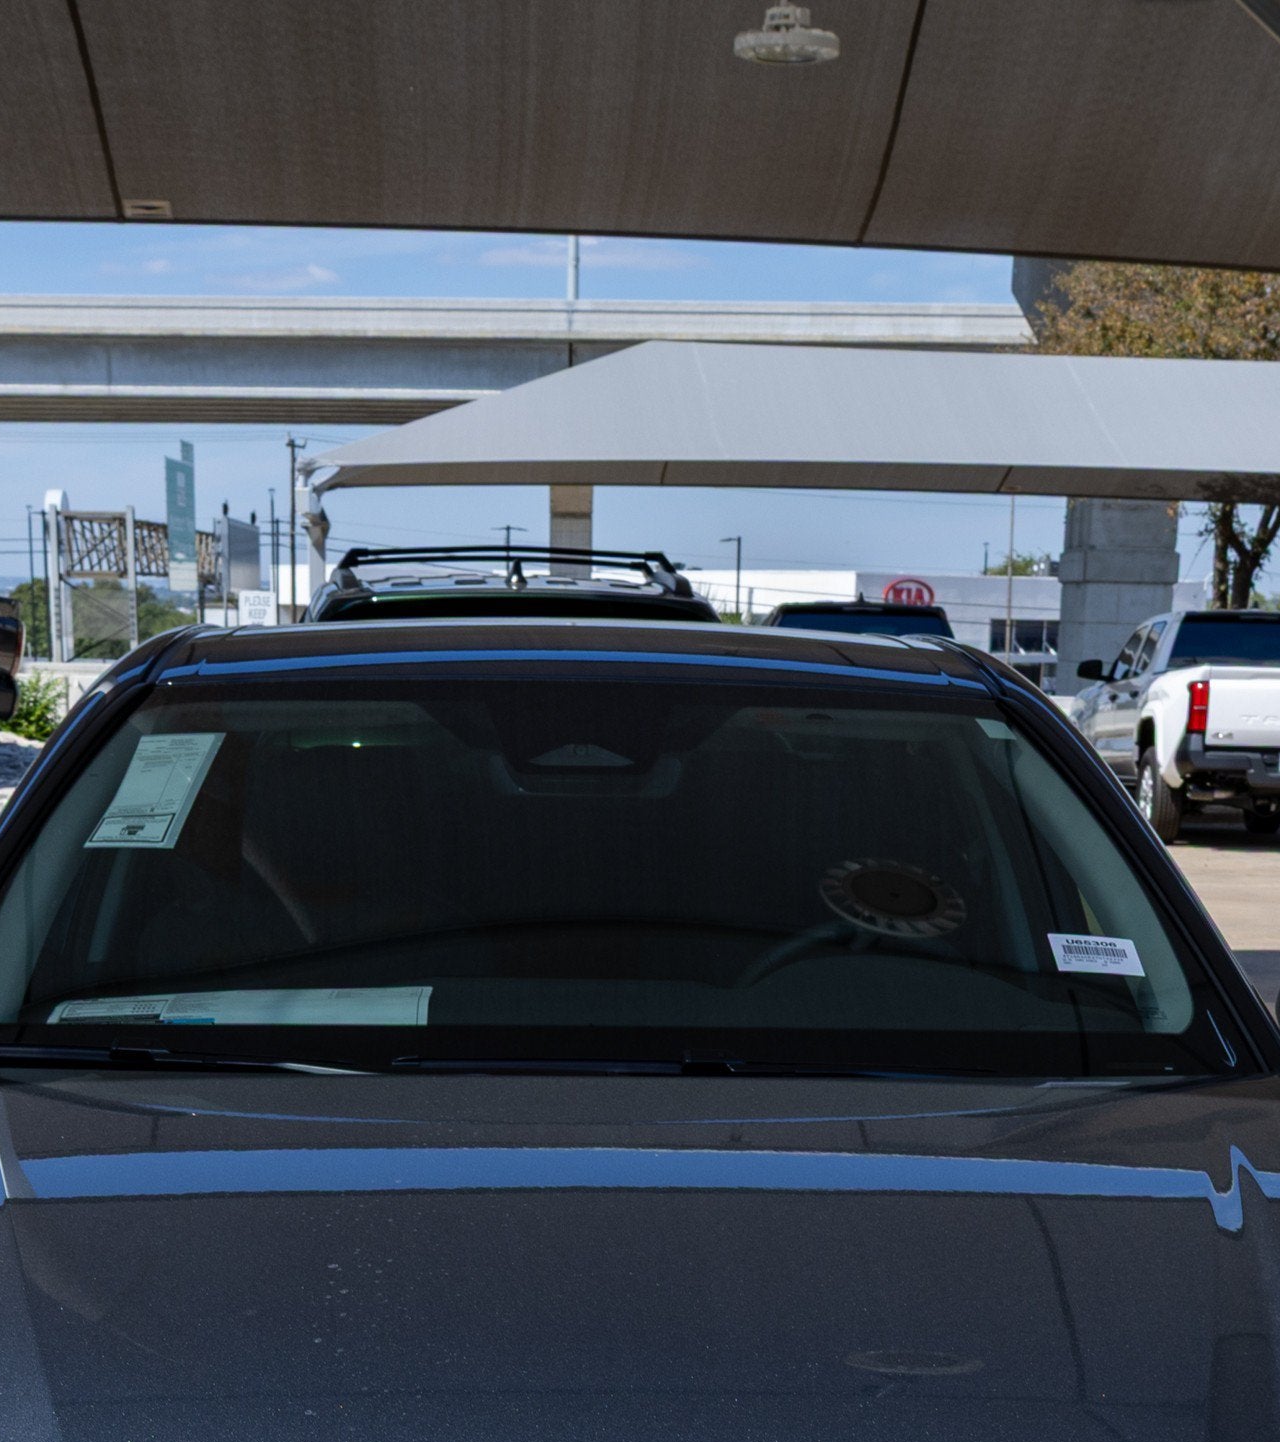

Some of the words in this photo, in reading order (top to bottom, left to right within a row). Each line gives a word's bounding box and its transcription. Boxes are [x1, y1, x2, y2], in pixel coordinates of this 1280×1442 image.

[244, 595, 271, 607] PLEASE
[893, 587, 926, 605] KIA
[249, 608, 267, 619] KEEP
